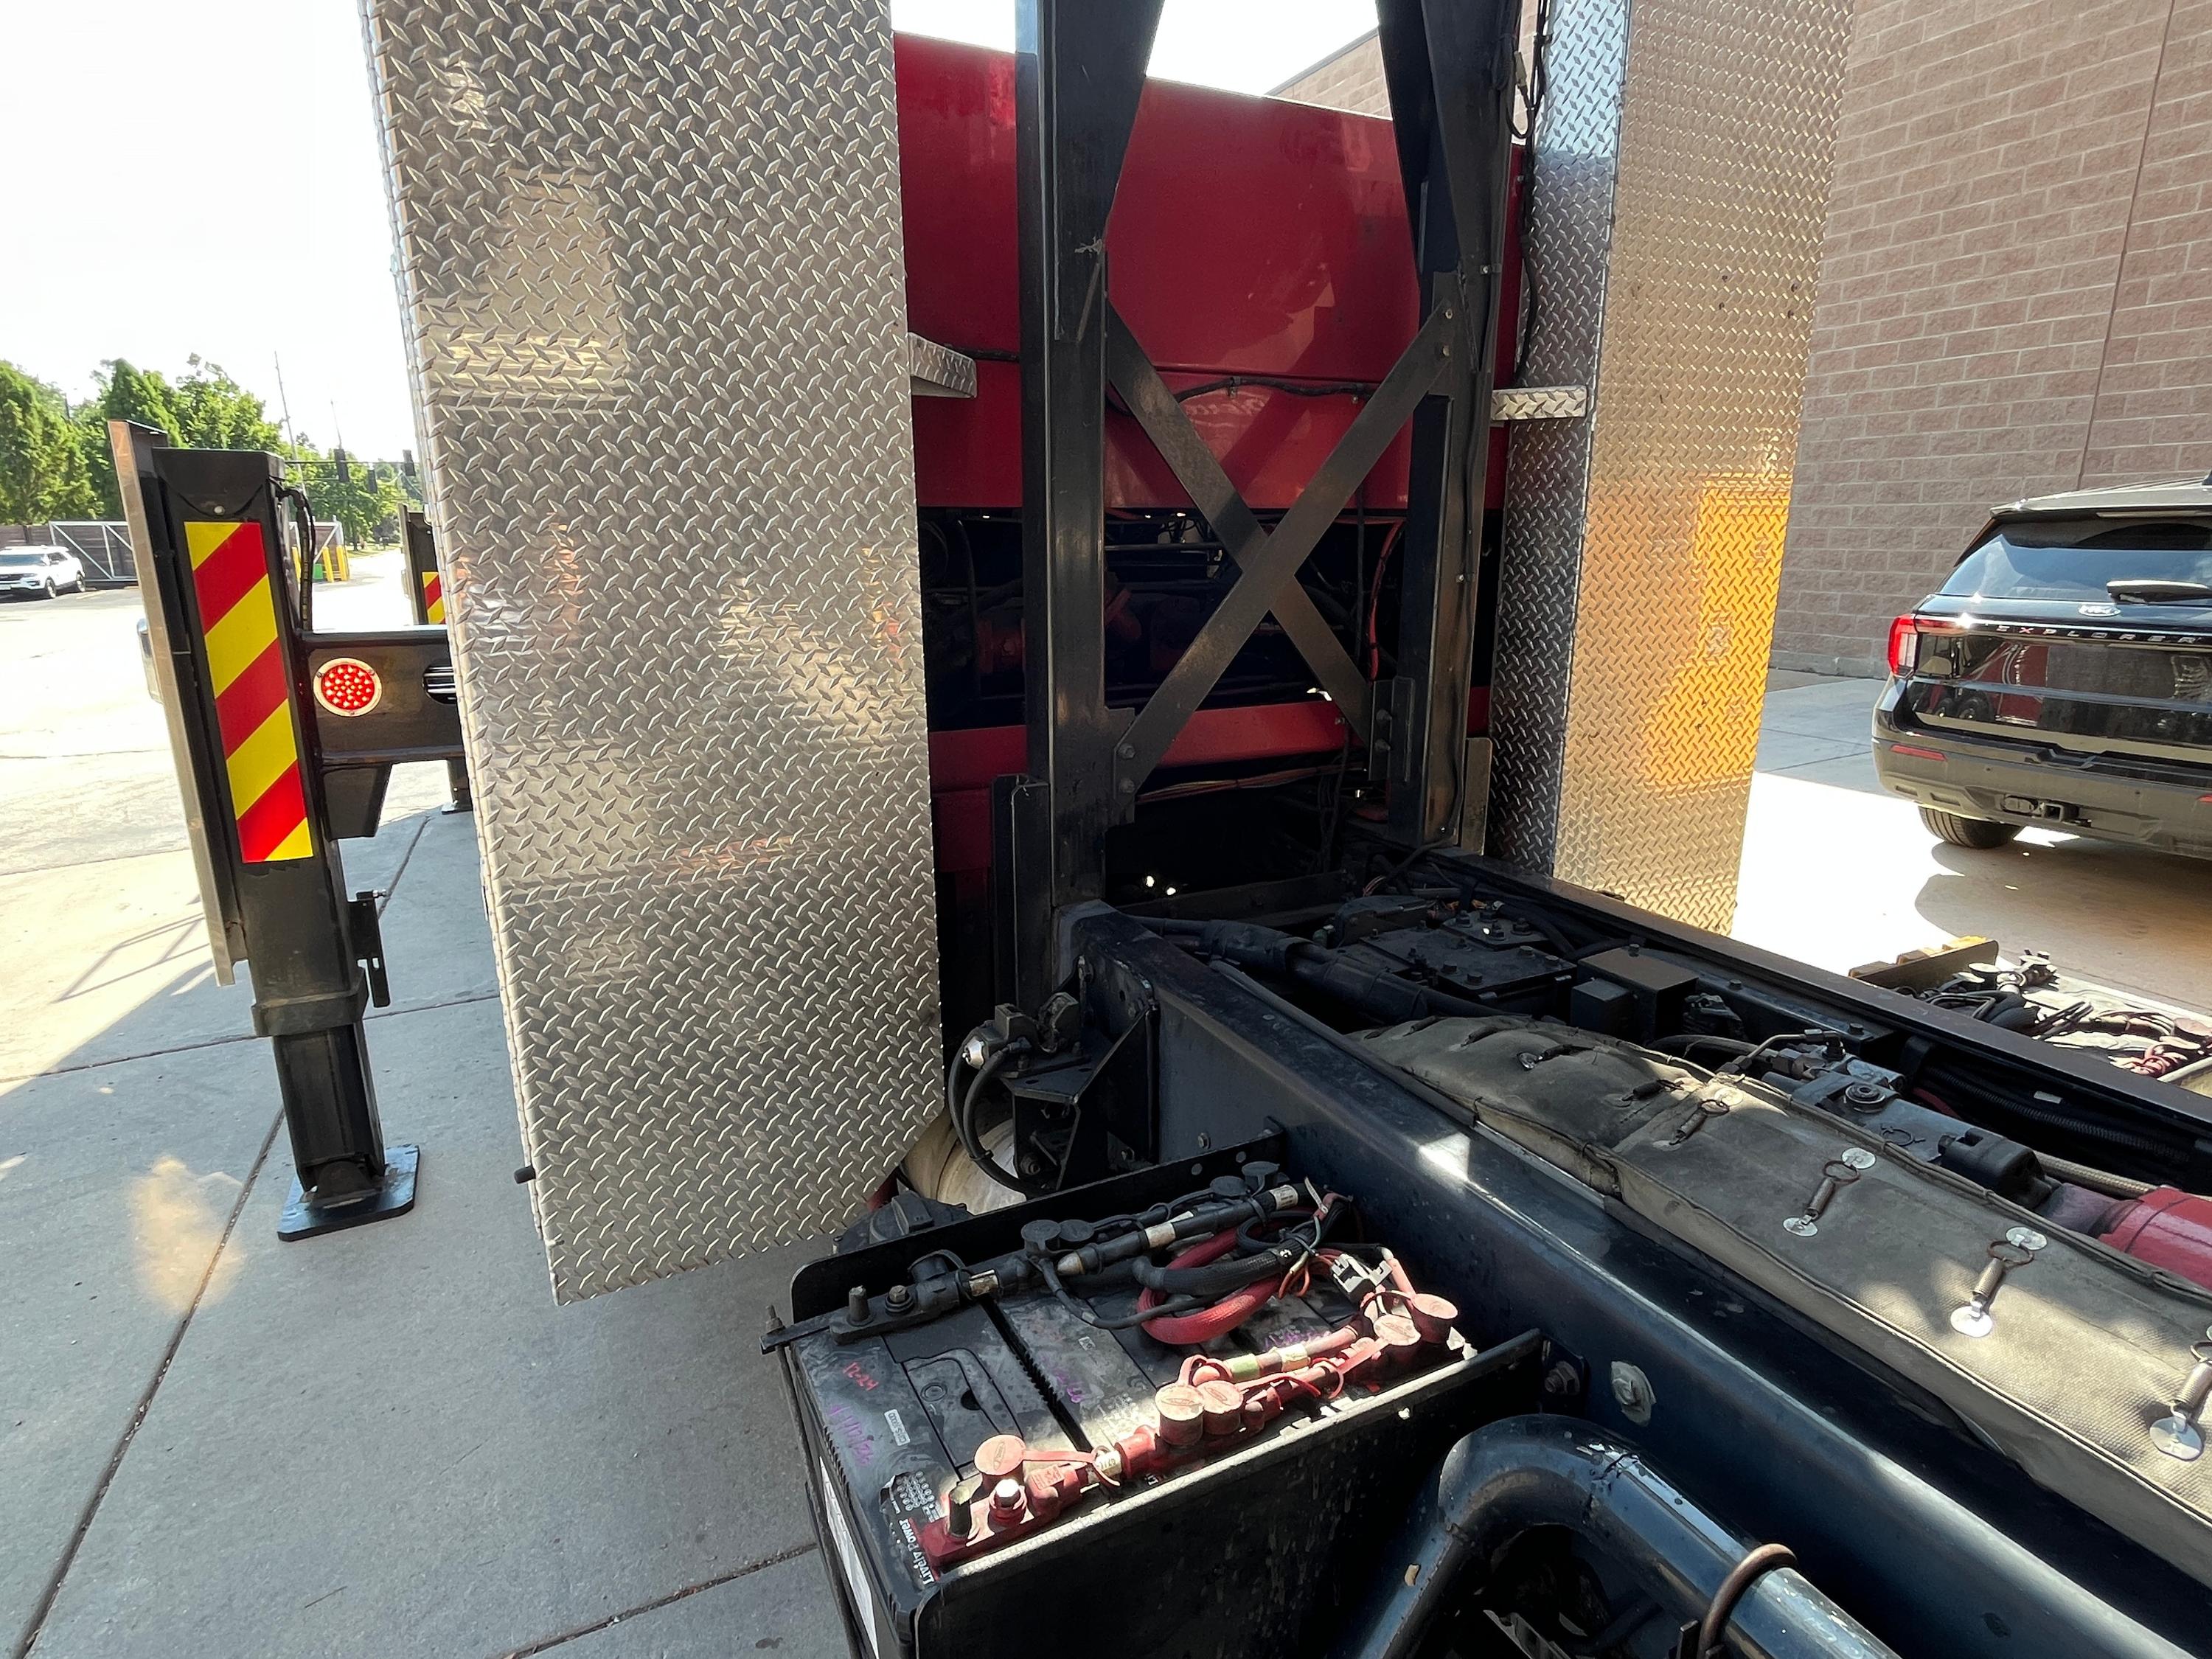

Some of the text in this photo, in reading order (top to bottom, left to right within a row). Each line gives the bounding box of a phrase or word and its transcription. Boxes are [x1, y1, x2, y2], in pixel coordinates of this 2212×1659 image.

[1997, 625, 2196, 644] EXPLORER
[899, 1518, 919, 1551] Power
[913, 1551, 934, 1585] Lively
